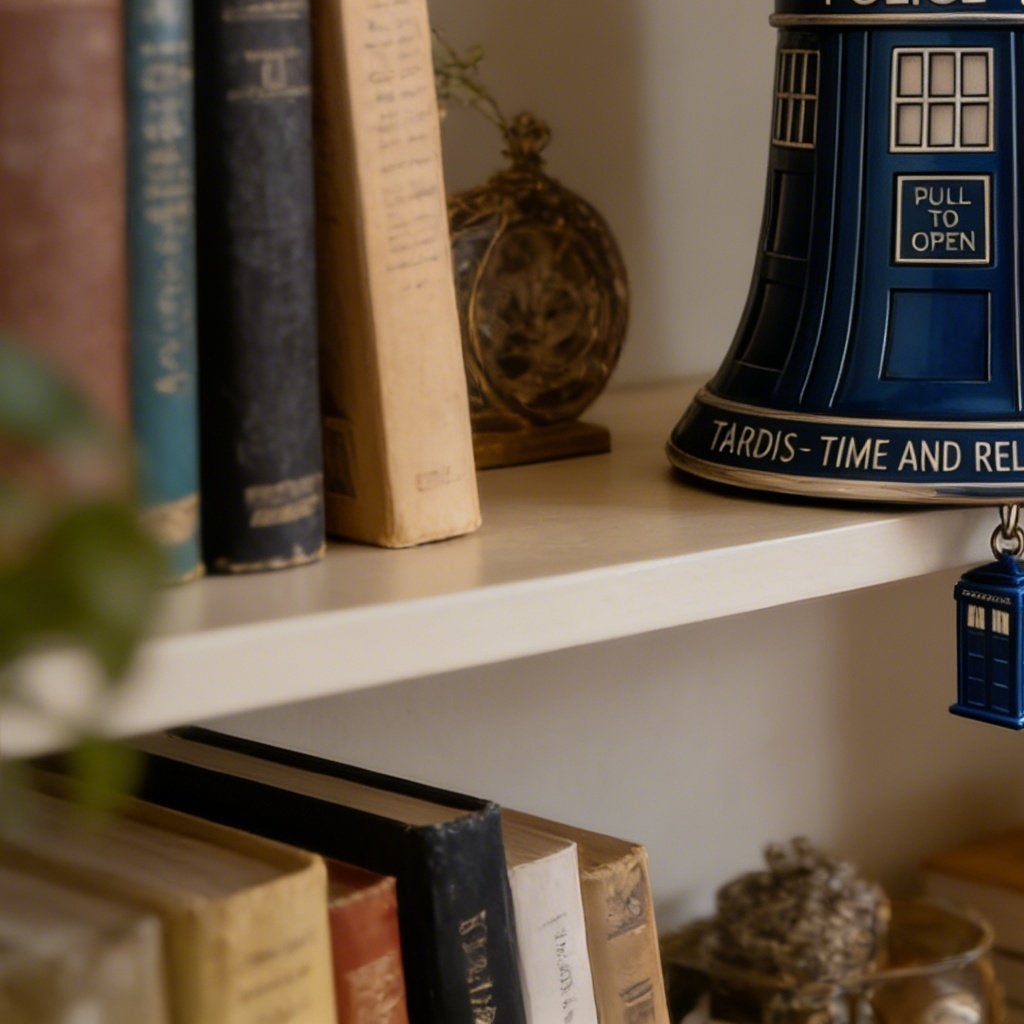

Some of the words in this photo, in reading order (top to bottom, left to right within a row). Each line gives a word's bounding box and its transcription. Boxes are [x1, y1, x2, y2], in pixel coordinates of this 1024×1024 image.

[914, 185, 972, 206] PULL
[927, 209, 959, 228] TO
[911, 230, 976, 252] OPEN
[820, 436, 890, 470] TIME
[897, 439, 962, 473] AND
